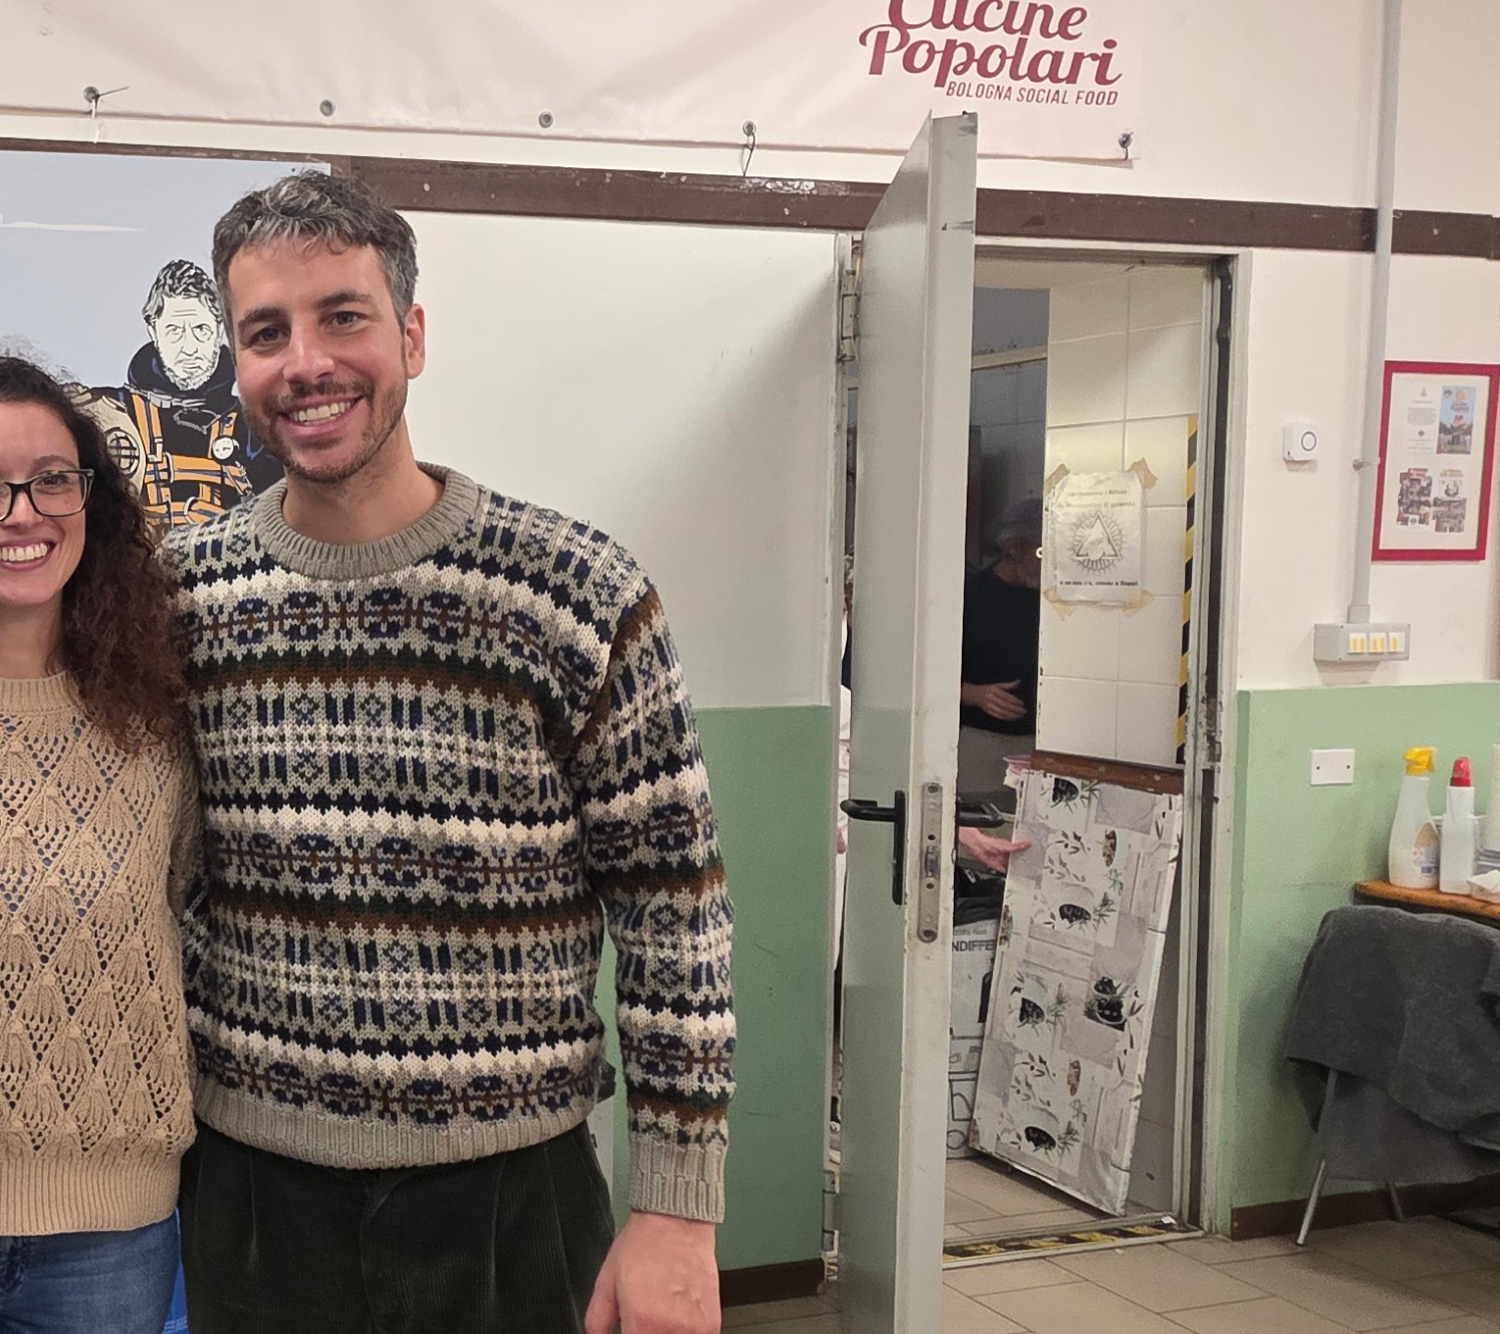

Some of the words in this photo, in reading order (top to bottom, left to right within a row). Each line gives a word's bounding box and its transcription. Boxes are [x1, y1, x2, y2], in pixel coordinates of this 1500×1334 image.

[858, 23, 1123, 88] Popolari
[946, 80, 1011, 102] BOLOGNA
[1016, 87, 1069, 105] SOCIAL
[1075, 90, 1119, 107] FOOD
